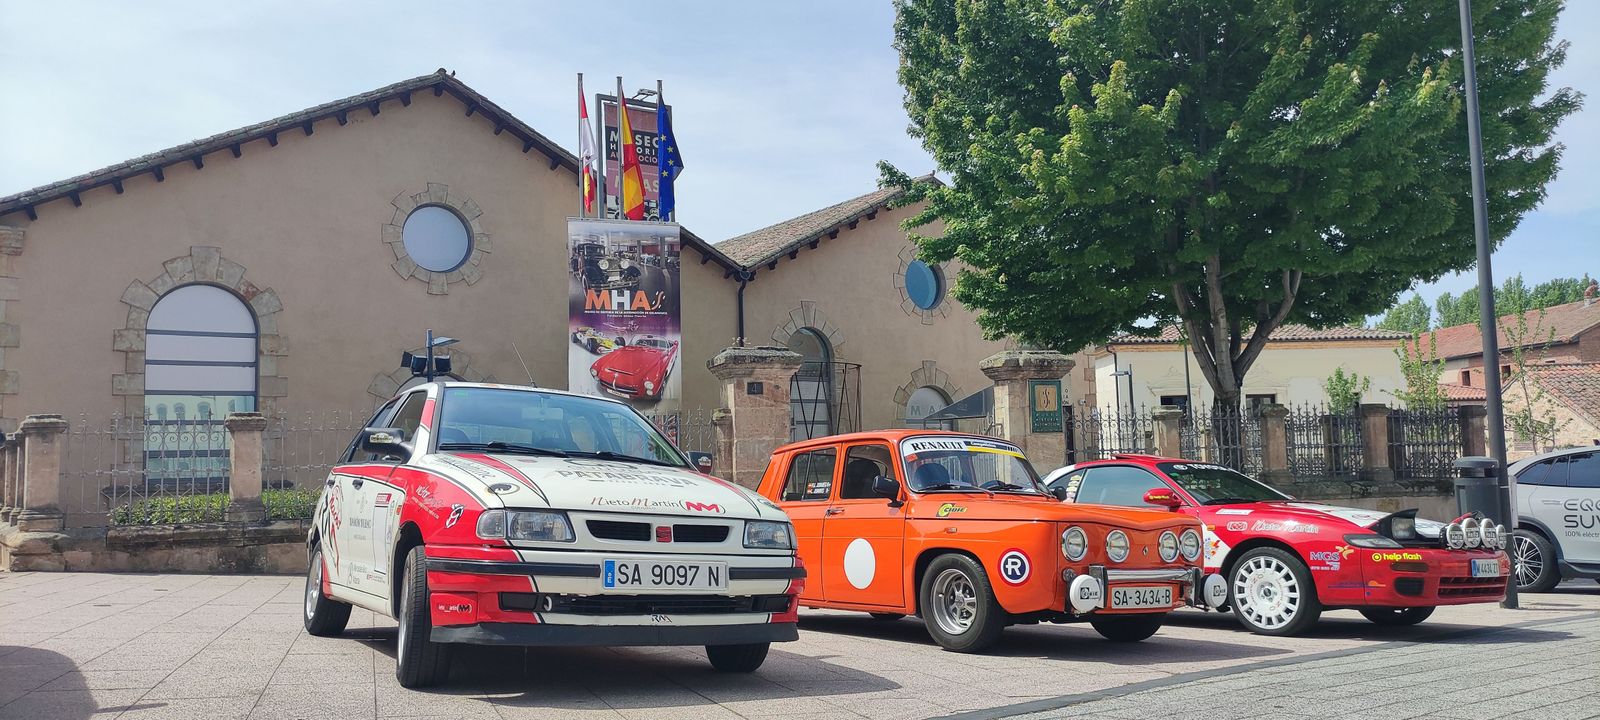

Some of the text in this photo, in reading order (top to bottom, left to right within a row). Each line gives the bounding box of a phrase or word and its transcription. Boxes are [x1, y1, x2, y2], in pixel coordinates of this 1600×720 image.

[911, 440, 964, 450] RENAULT
[557, 470, 697, 487] PATABRAVA
[1310, 552, 1340, 560] MGS
[1384, 552, 1402, 562] help
[618, 564, 642, 584] SA
[651, 564, 700, 586] 9097
[708, 566, 719, 586] N
[1006, 558, 1022, 576] R
[1114, 588, 1171, 606] SA-3434-B
